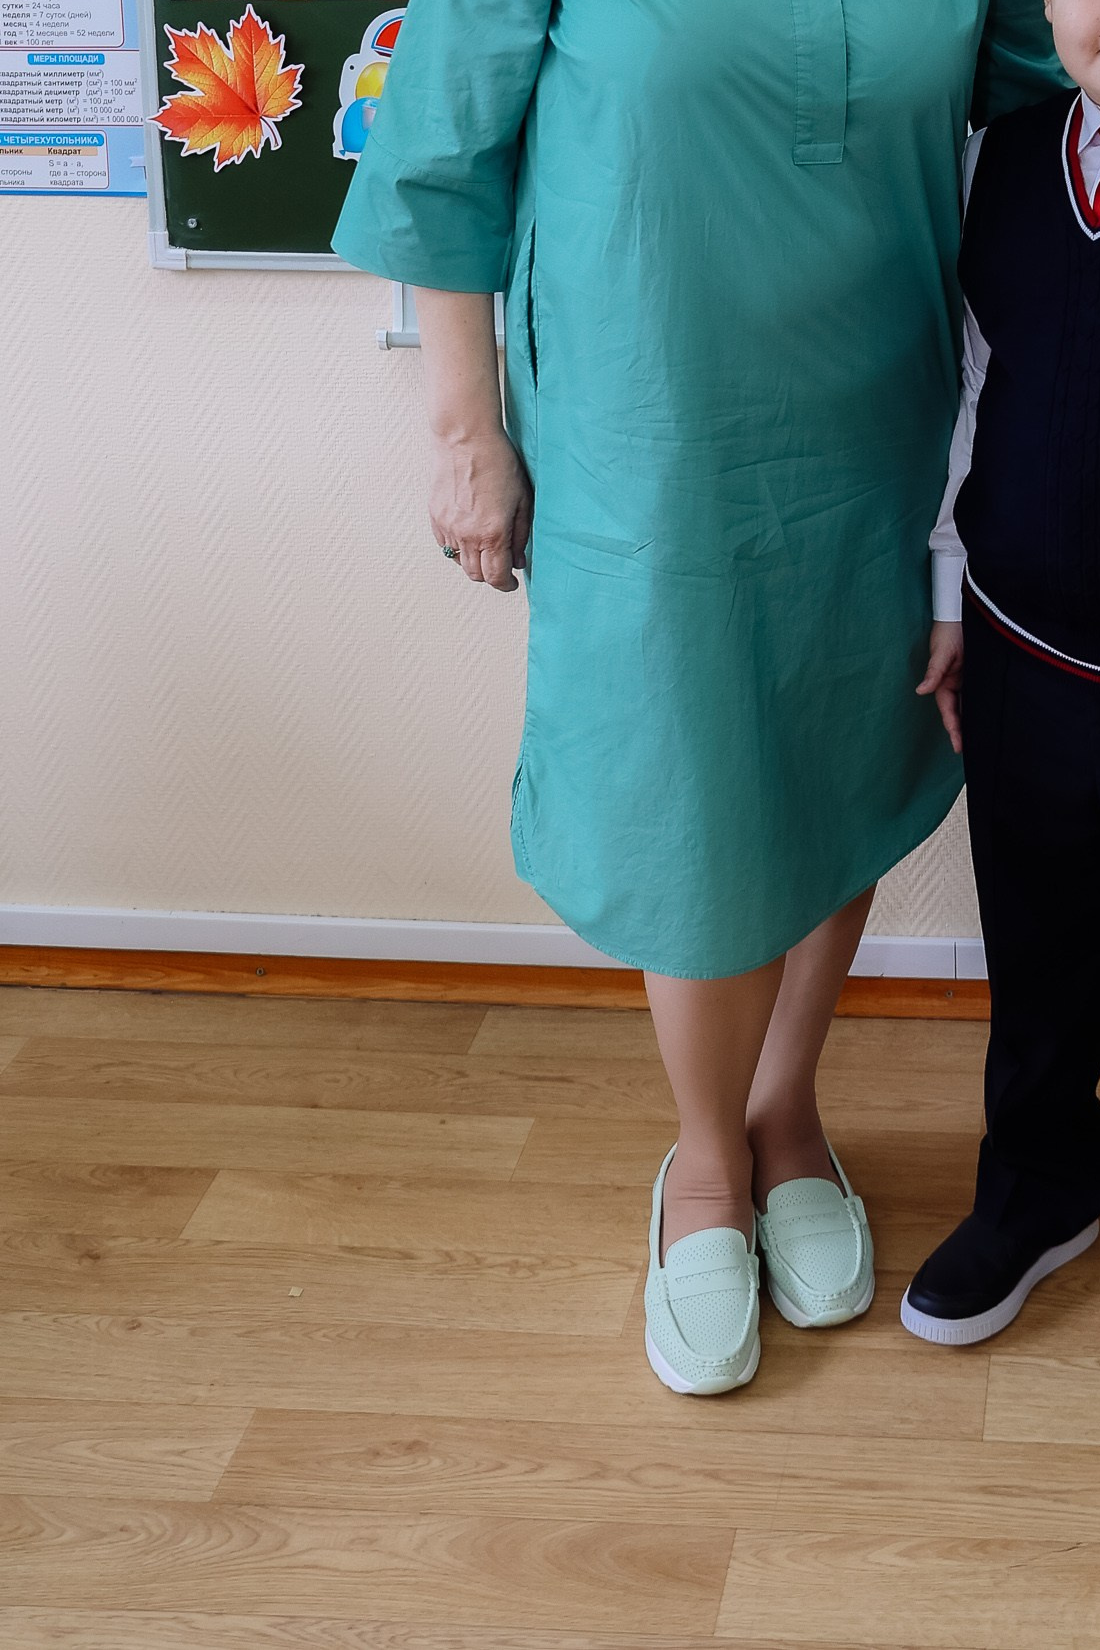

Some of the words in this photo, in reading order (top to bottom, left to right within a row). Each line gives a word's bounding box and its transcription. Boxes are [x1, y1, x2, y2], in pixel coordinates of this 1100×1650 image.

[67, 11, 92, 20] (дней)
[33, 55, 57, 63] МЕРЫ
[58, 55, 99, 64] ПЛОЩАДИ
[44, 89, 80, 97] дециметр
[4, 135, 99, 145] ЧЕТЫРЕХУГОЛЬНИКА
[47, 148, 81, 156] Квадрат
